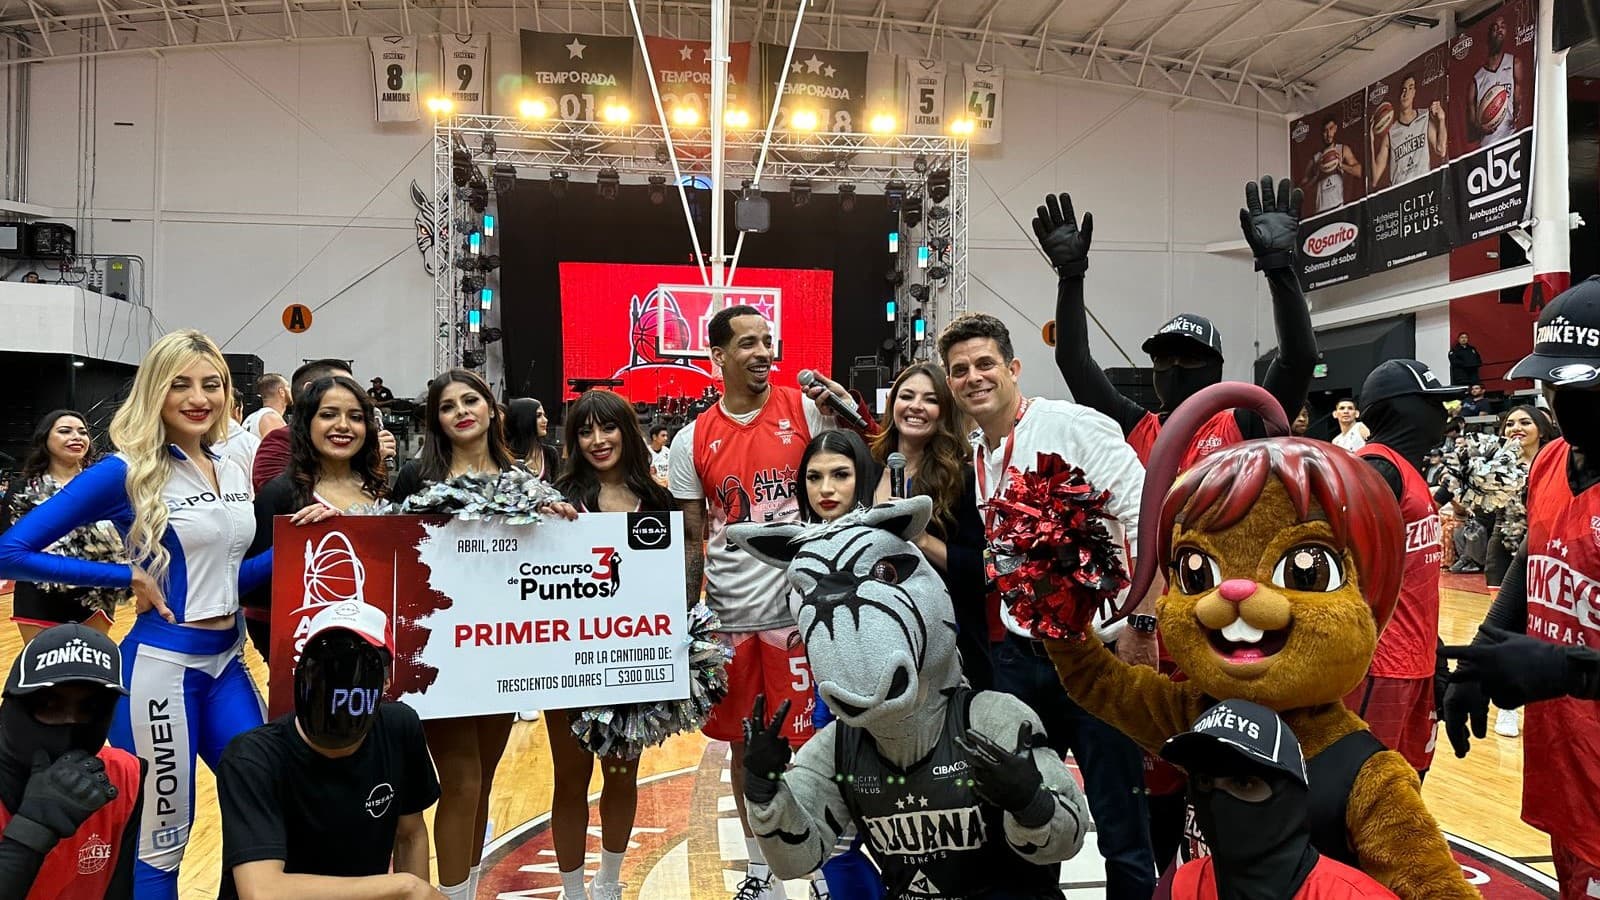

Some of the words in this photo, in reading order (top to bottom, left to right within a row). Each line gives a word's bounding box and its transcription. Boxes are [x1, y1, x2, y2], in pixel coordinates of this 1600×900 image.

[387, 64, 403, 90] 8
[457, 64, 472, 90] 9
[535, 71, 617, 86] TEMPORADA
[919, 88, 935, 114] 5
[968, 91, 996, 119] 41
[1467, 149, 1520, 195] abc
[1404, 190, 1434, 212] CITY
[1403, 204, 1439, 223] EXPRESS
[1404, 214, 1439, 237] PLUS
[1307, 226, 1354, 254] Rosarito
[1529, 282, 1546, 312] A
[290, 306, 305, 329] A
[1536, 325, 1600, 347] ZONKEYS
[754, 469, 782, 487] ALL
[754, 481, 798, 502] STAR
[457, 539, 489, 554] ABRIL,
[492, 538, 518, 552] 2023
[519, 562, 593, 576] Concurso
[591, 547, 615, 580] 3
[520, 578, 610, 600] Puntos
[454, 619, 571, 648] PRIMER
[579, 614, 672, 641] LUGAR
[35, 644, 112, 672] ZONKEYS
[575, 651, 594, 665] POR
[596, 650, 608, 663] LA
[610, 648, 655, 663] CANTIDAD
[658, 646, 672, 660] DE:
[496, 676, 559, 693] TRESCIENTOS
[561, 673, 602, 688] DOLARES
[618, 669, 642, 684] $300
[645, 668, 665, 682] DLLS
[365, 791, 395, 809] NISSAN
